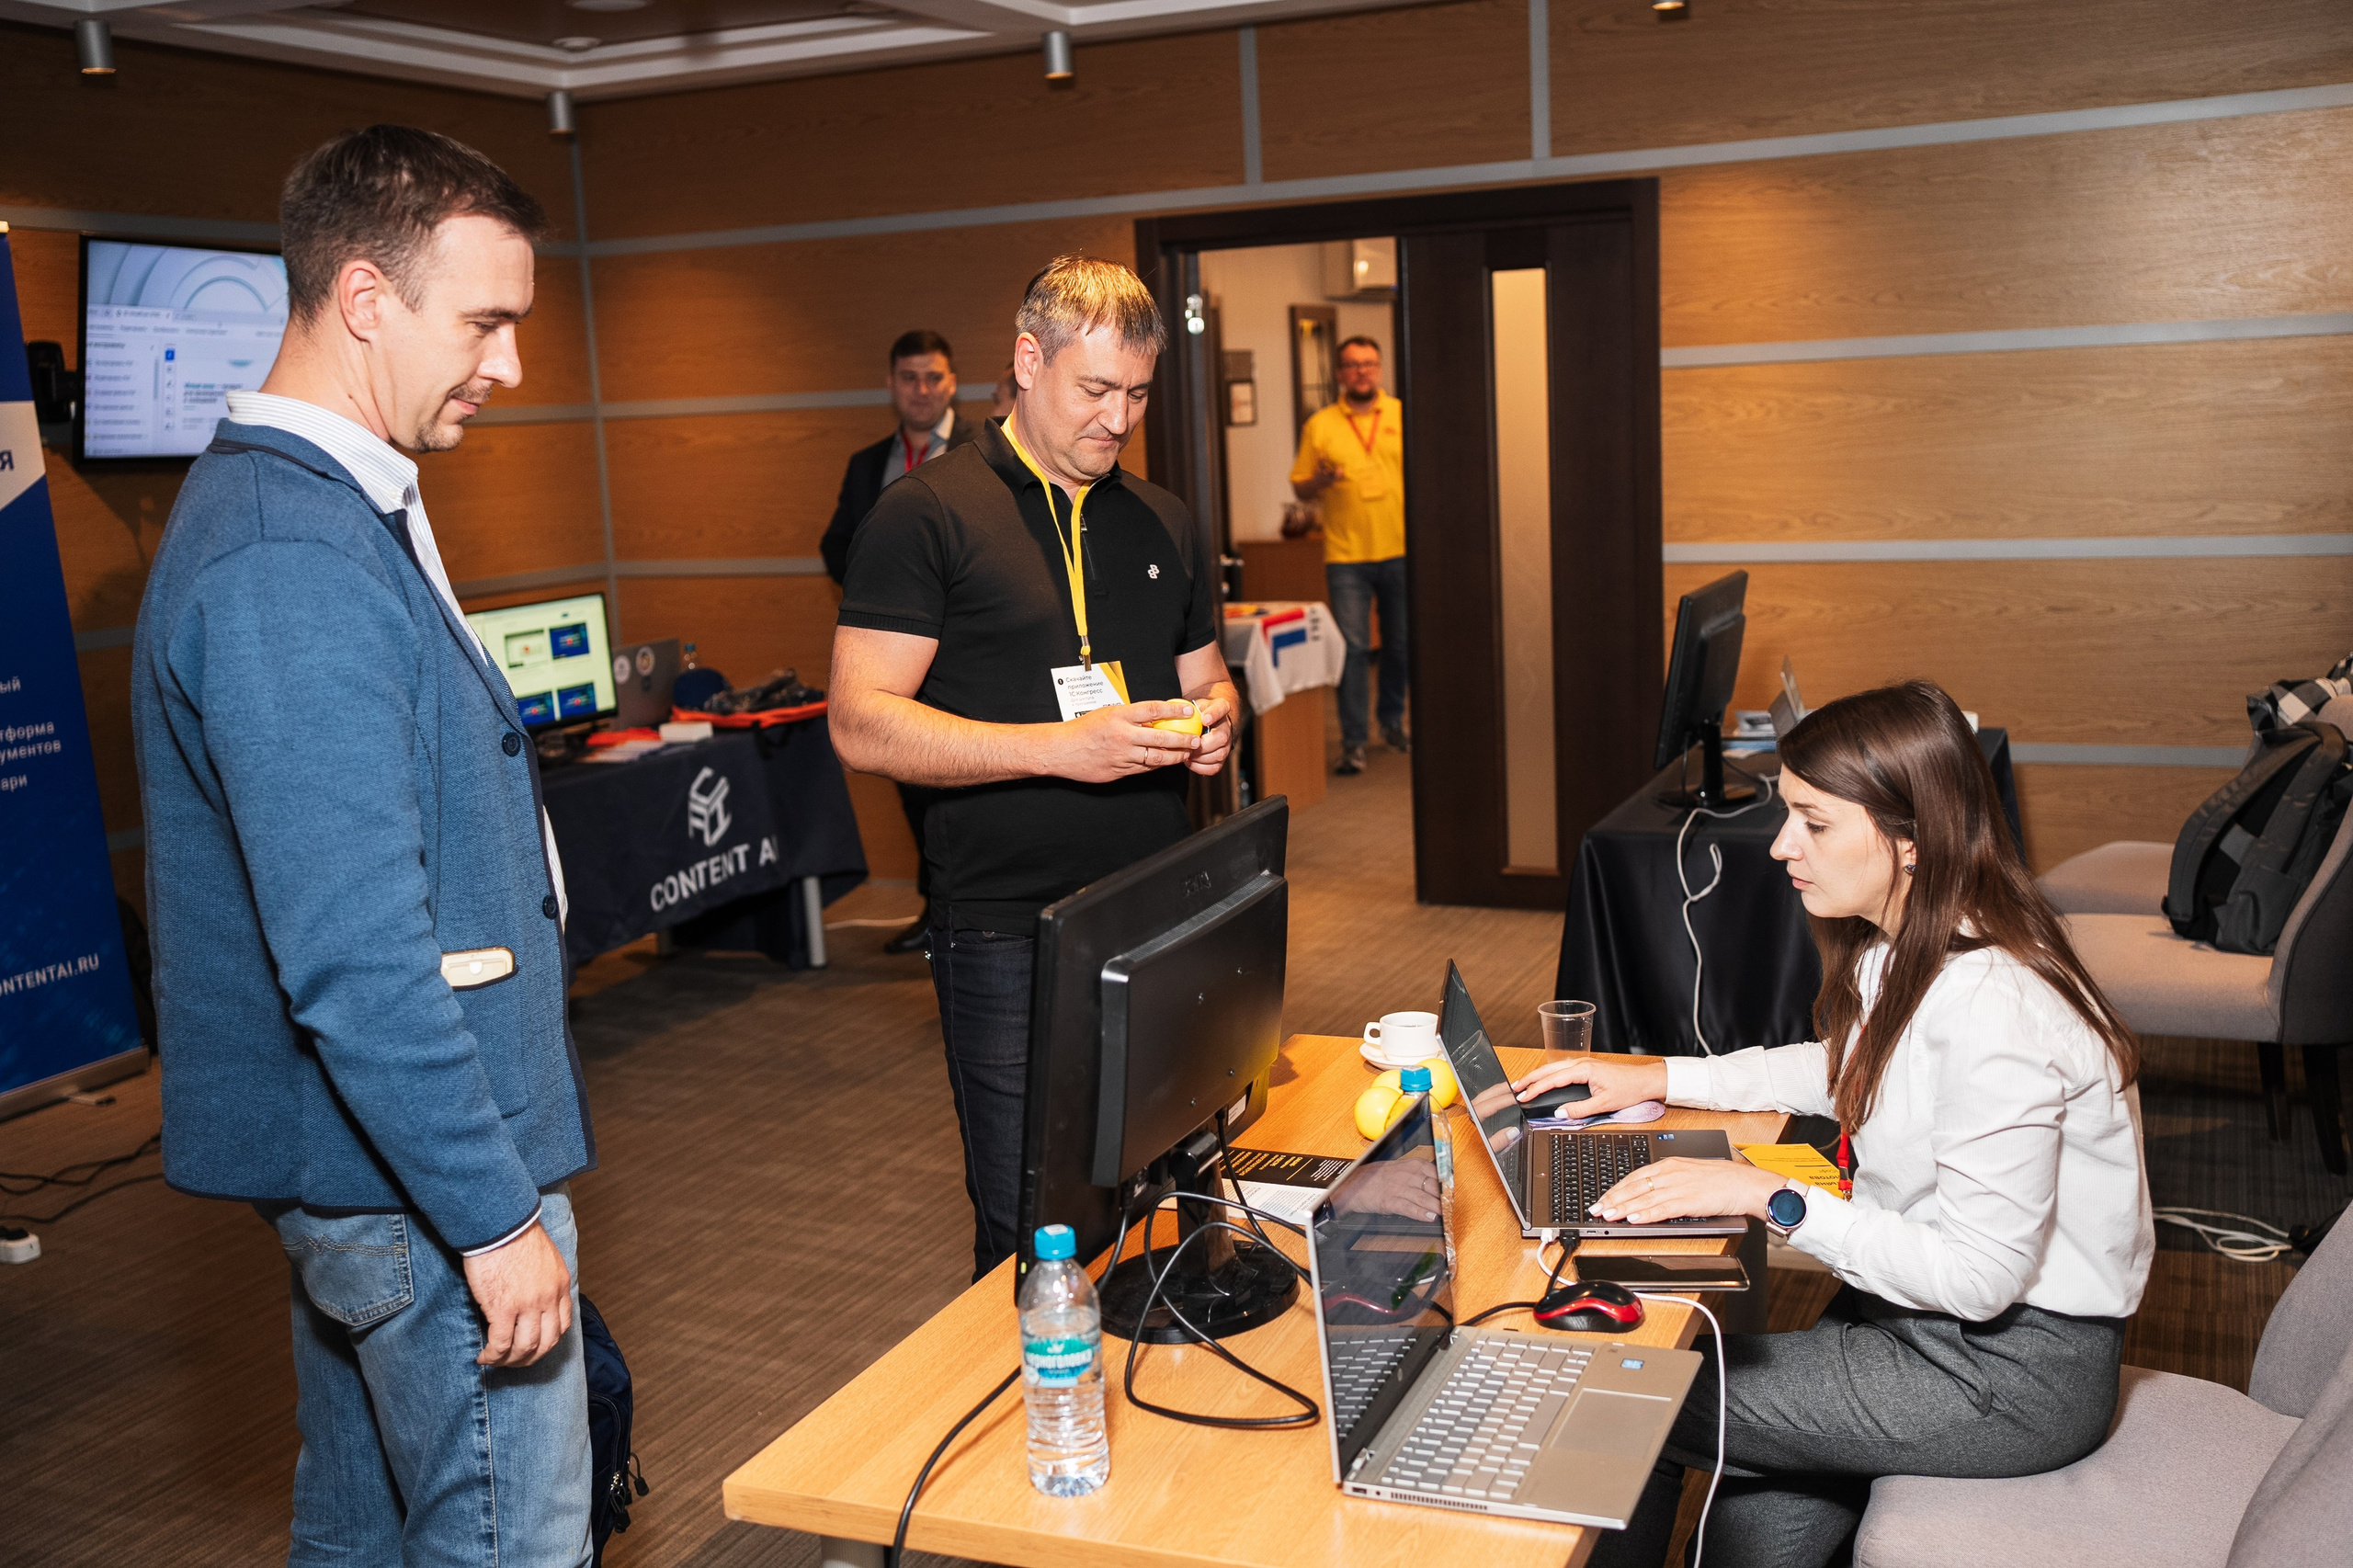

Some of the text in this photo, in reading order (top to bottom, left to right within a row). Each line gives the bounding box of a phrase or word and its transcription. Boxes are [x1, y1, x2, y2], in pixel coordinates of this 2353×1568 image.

[1067, 681, 1104, 690] приложение
[650, 843, 750, 912] CONTENT
[0, 952, 99, 997] NTENTAI.RU
